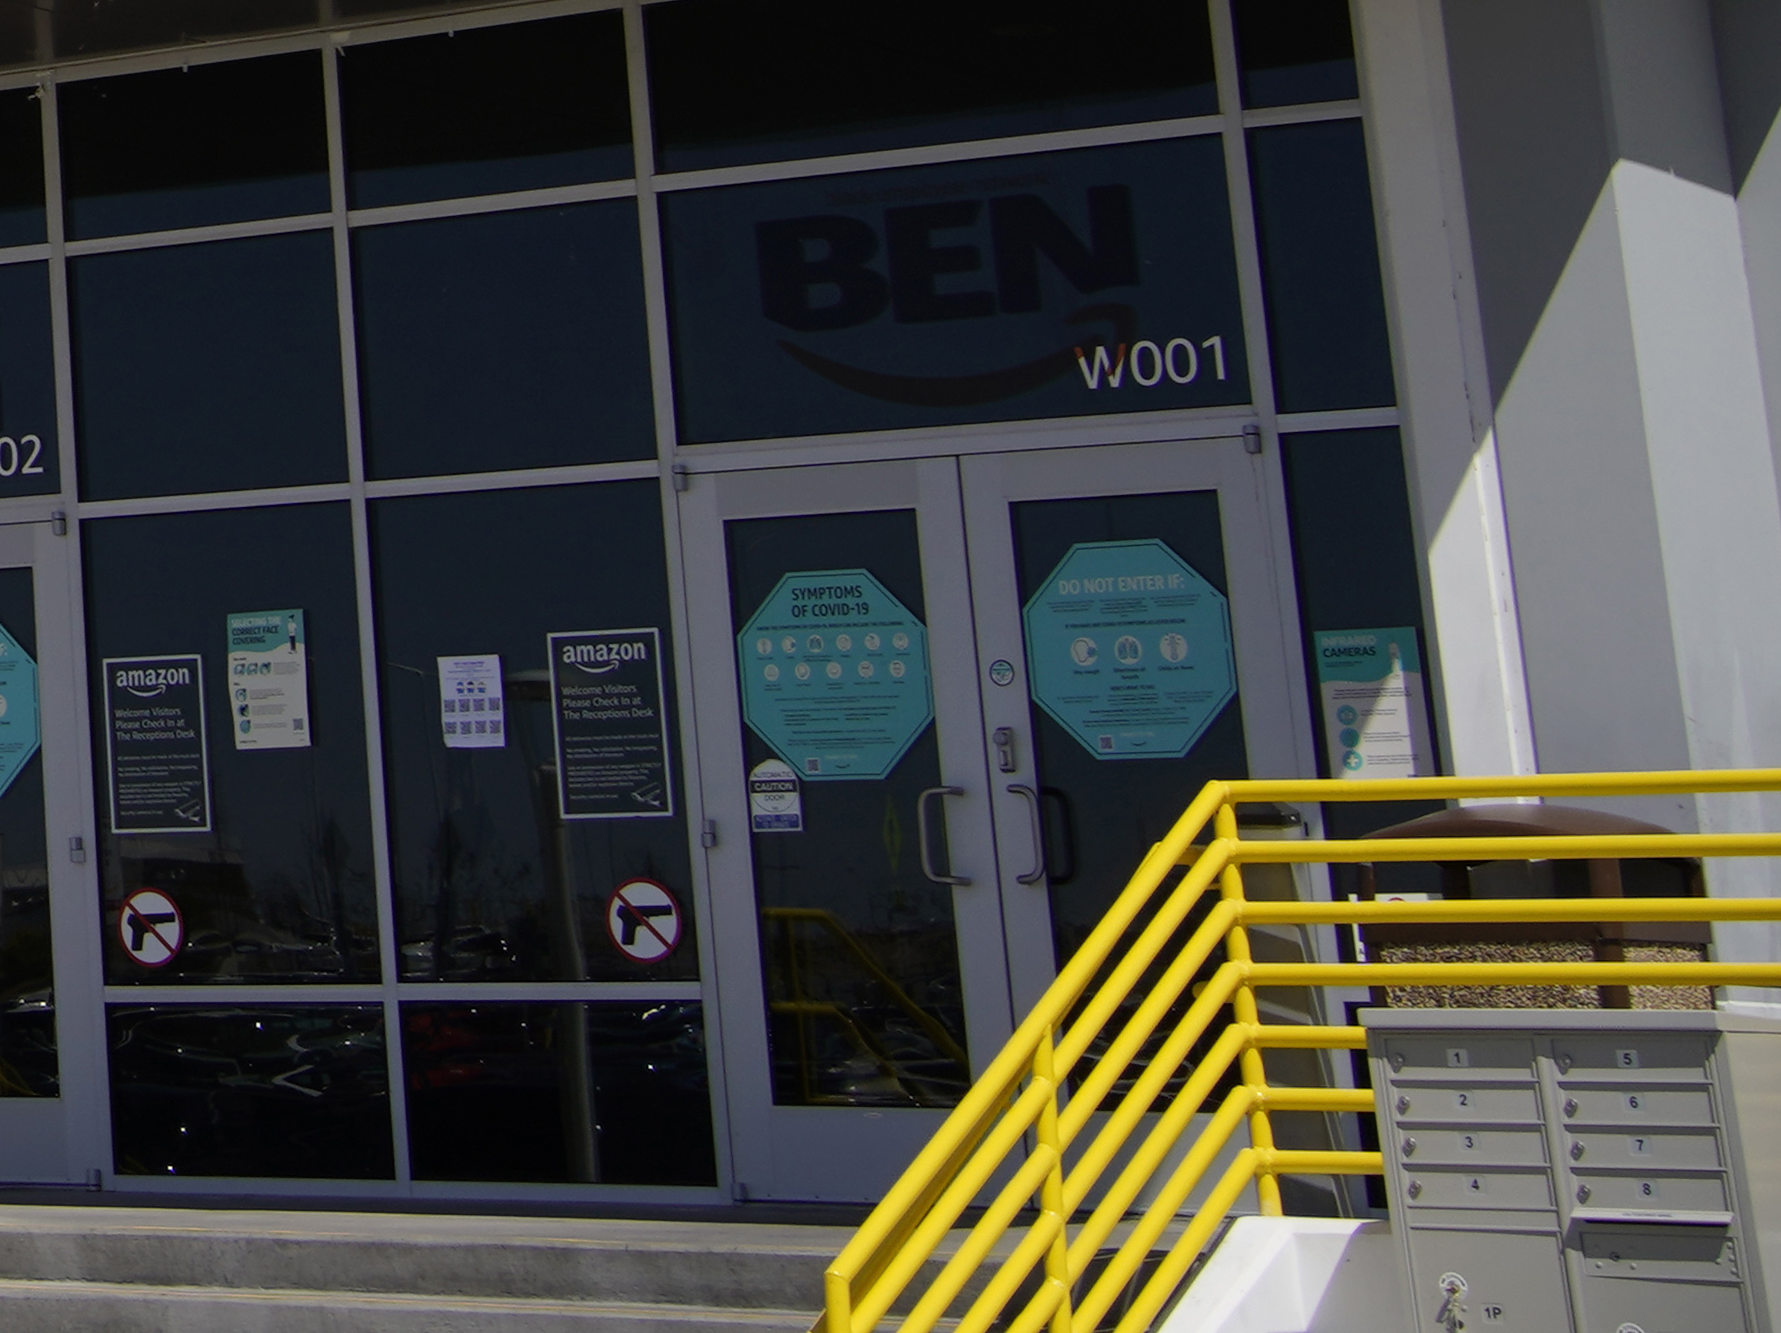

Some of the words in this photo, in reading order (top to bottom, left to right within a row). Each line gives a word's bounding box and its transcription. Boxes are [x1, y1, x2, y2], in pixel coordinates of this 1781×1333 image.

[755, 183, 1141, 332] BEN
[1074, 334, 1232, 390] W001
[1059, 580, 1080, 595] DO
[1085, 577, 1114, 593] NOT
[1118, 575, 1165, 592] ENTER
[1167, 574, 1184, 589] IF:
[792, 585, 863, 601] SYMPTOMS
[791, 604, 808, 618] OF
[811, 602, 870, 618] COVID-19
[262, 625, 279, 634] FACE
[562, 642, 646, 664] amazon
[1323, 646, 1377, 658] CAMERAS
[116, 667, 190, 688] amazon
[561, 686, 602, 696] Welcome
[603, 684, 637, 694] Visitors
[562, 699, 591, 708] Please
[593, 697, 619, 707] Check
[115, 708, 150, 718] Welcome
[151, 707, 181, 717] Visitors
[563, 711, 580, 720] The
[631, 707, 654, 717] Desk
[116, 720, 140, 730] Please
[142, 719, 165, 729] Check
[117, 732, 130, 741] The
[176, 729, 196, 739] Desk
[754, 782, 794, 791] CAUTION
[1453, 1053, 1461, 1064] 1
[1623, 1054, 1632, 1065] 5
[1459, 1094, 1468, 1106] 2
[1629, 1096, 1639, 1109] 6
[1465, 1137, 1474, 1148] 3
[1636, 1140, 1644, 1151] 7
[1471, 1179, 1480, 1190] 4
[1642, 1183, 1652, 1195] 8
[1484, 1306, 1502, 1319] 1P
